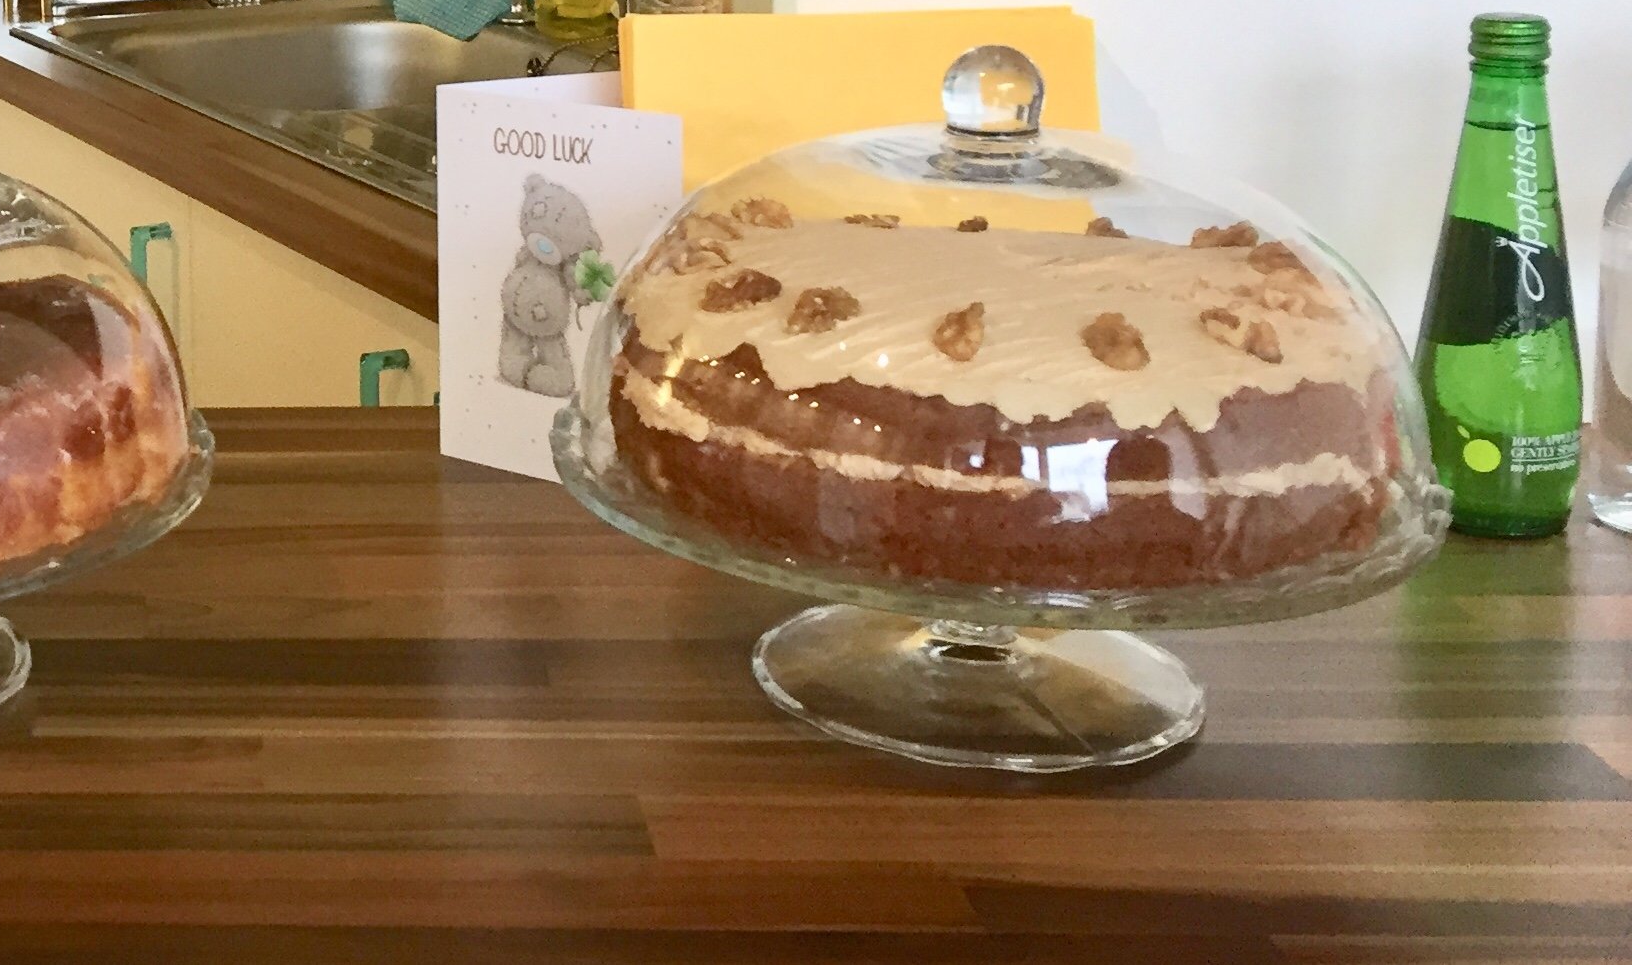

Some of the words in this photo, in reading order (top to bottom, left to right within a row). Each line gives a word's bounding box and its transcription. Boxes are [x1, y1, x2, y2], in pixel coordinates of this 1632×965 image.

[494, 127, 546, 160] GOOD
[553, 134, 594, 165] LUCK
[1506, 114, 1548, 302] Appletiser
